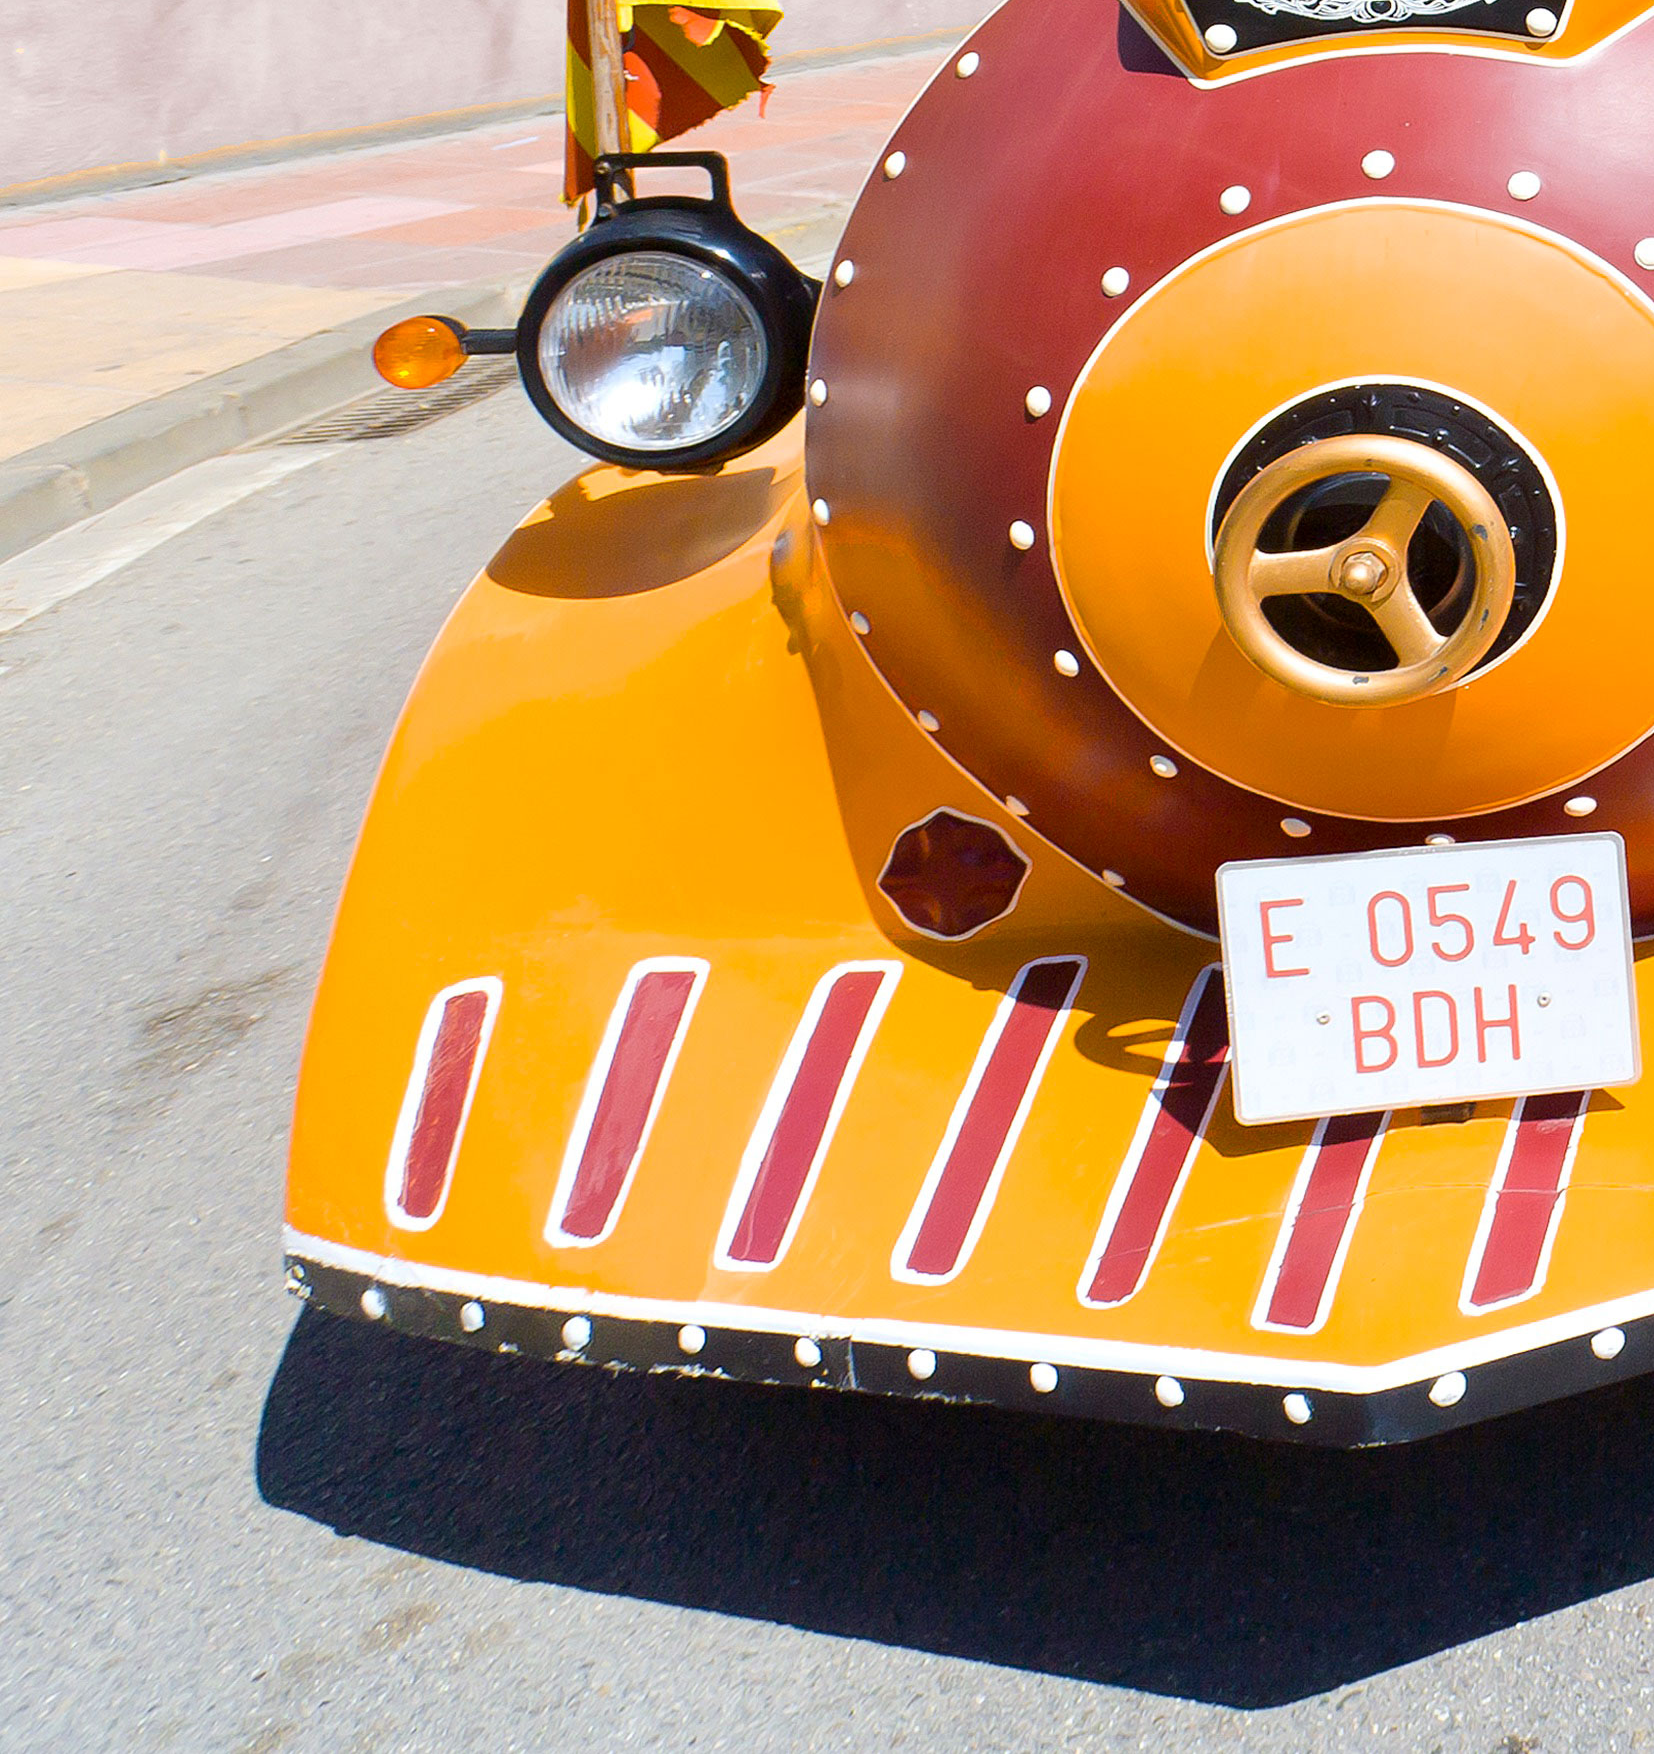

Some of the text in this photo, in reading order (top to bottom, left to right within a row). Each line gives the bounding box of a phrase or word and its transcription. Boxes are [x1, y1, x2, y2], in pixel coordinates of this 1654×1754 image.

[1260, 875, 1595, 978] E 0549
[1351, 984, 1521, 1074] BDH
